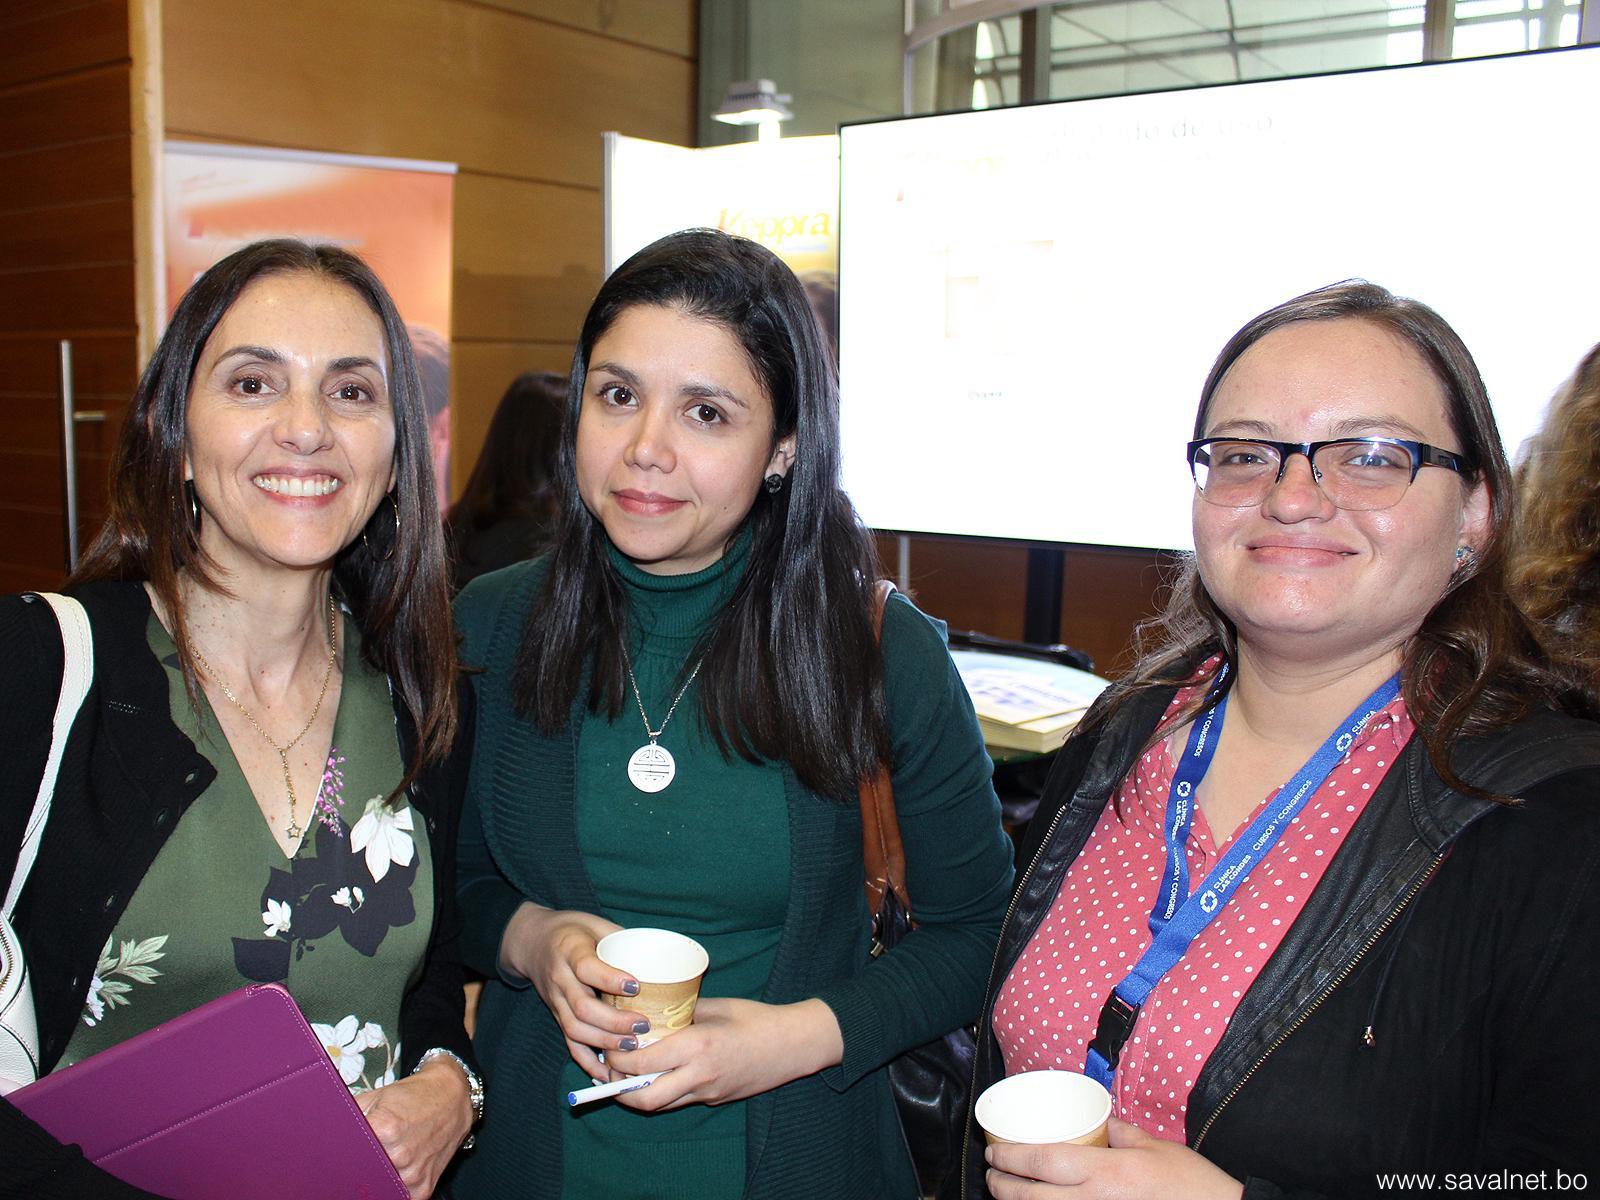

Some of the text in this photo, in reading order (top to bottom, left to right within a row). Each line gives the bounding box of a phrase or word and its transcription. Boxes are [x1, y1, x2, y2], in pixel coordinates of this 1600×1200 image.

[1193, 720, 1212, 757] CONGRESOS
[1252, 824, 1276, 851] CURSOS
[1277, 780, 1312, 820] CONGRESOS
[1217, 854, 1252, 893] LAS CONDES
[1163, 882, 1179, 920] CONGRESOS
